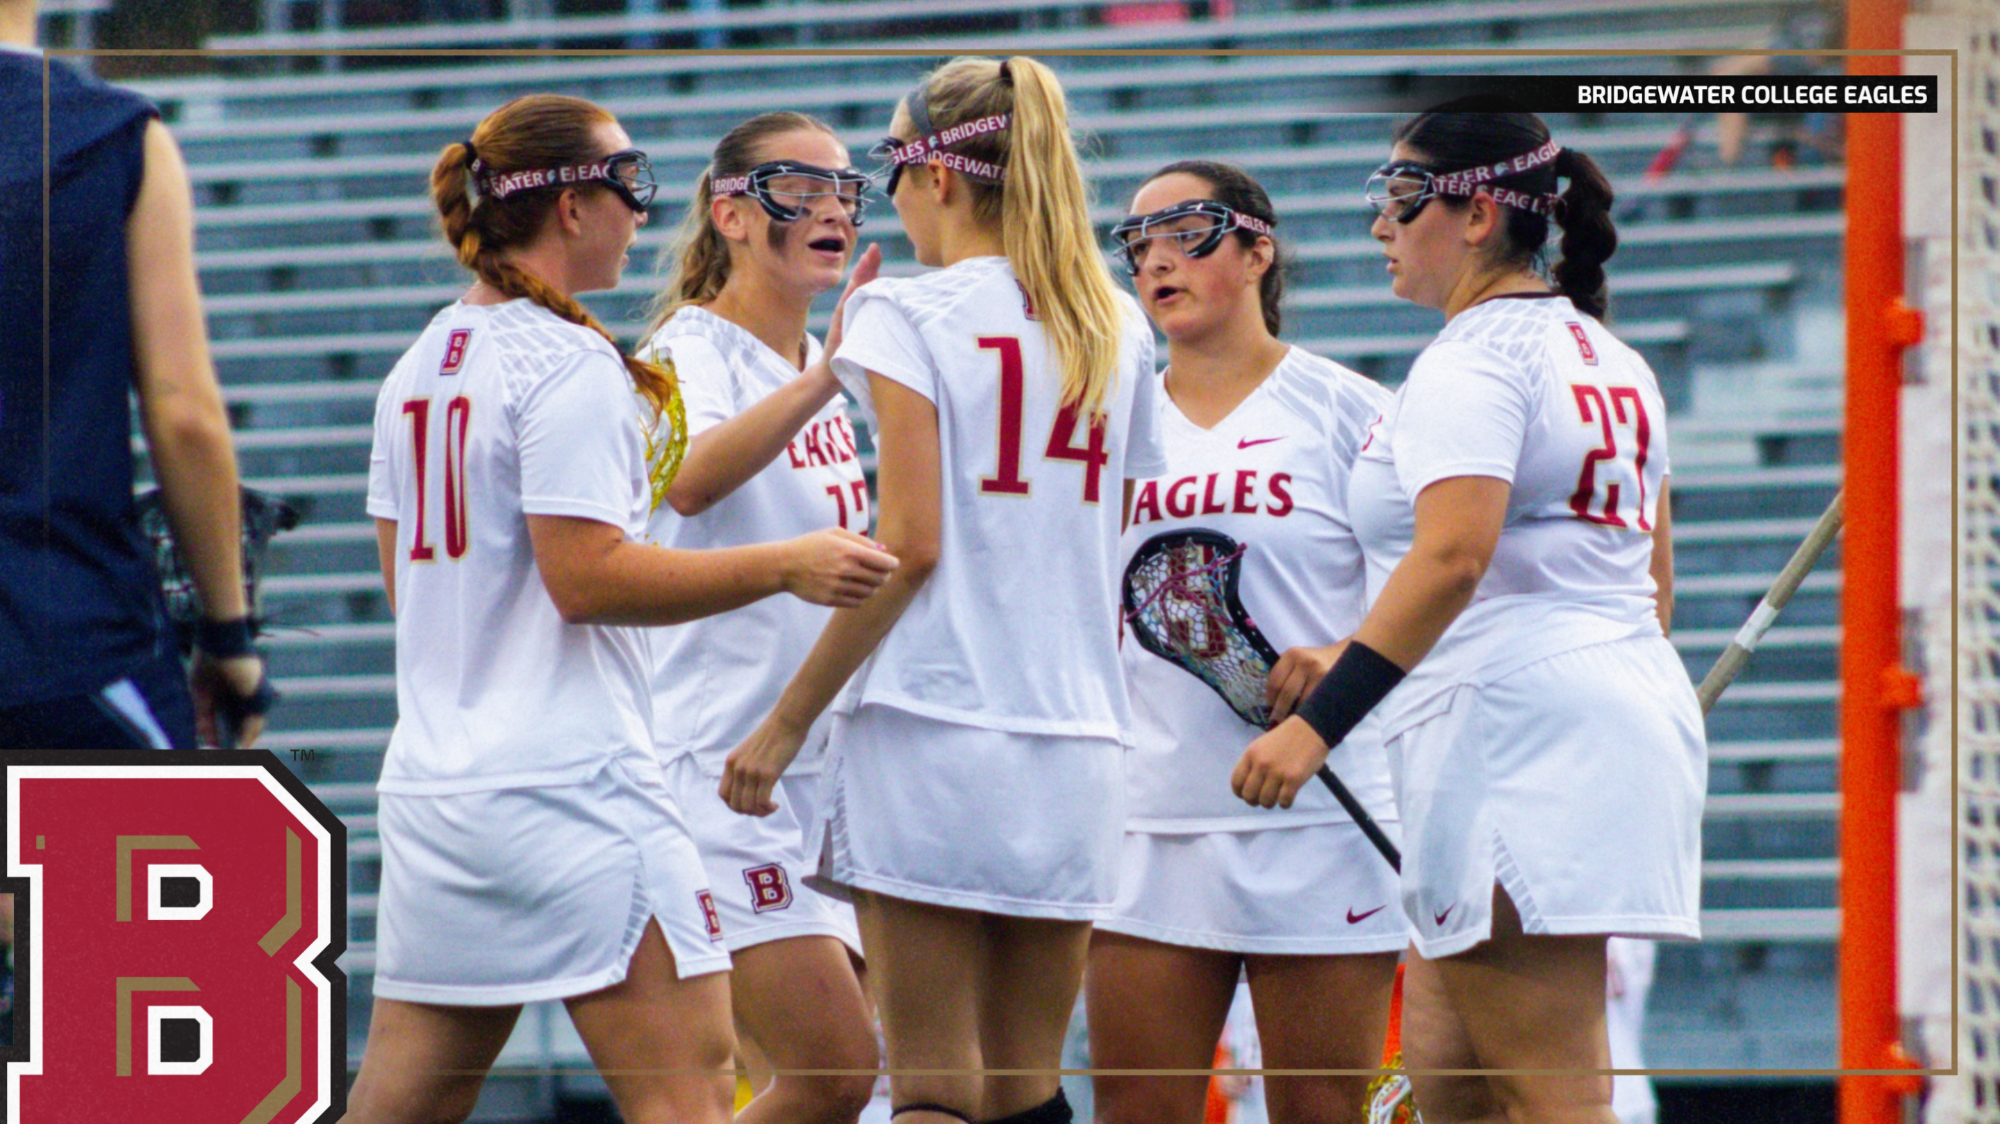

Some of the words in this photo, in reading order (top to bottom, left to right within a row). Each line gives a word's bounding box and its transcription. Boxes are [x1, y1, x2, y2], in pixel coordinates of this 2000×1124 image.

[439, 328, 472, 376] B
[1565, 321, 1599, 366] B
[974, 333, 1111, 507] 14
[402, 394, 471, 564] 10
[1569, 382, 1652, 532] 27
[1132, 469, 1294, 525] AGLES
[742, 862, 794, 915] B
